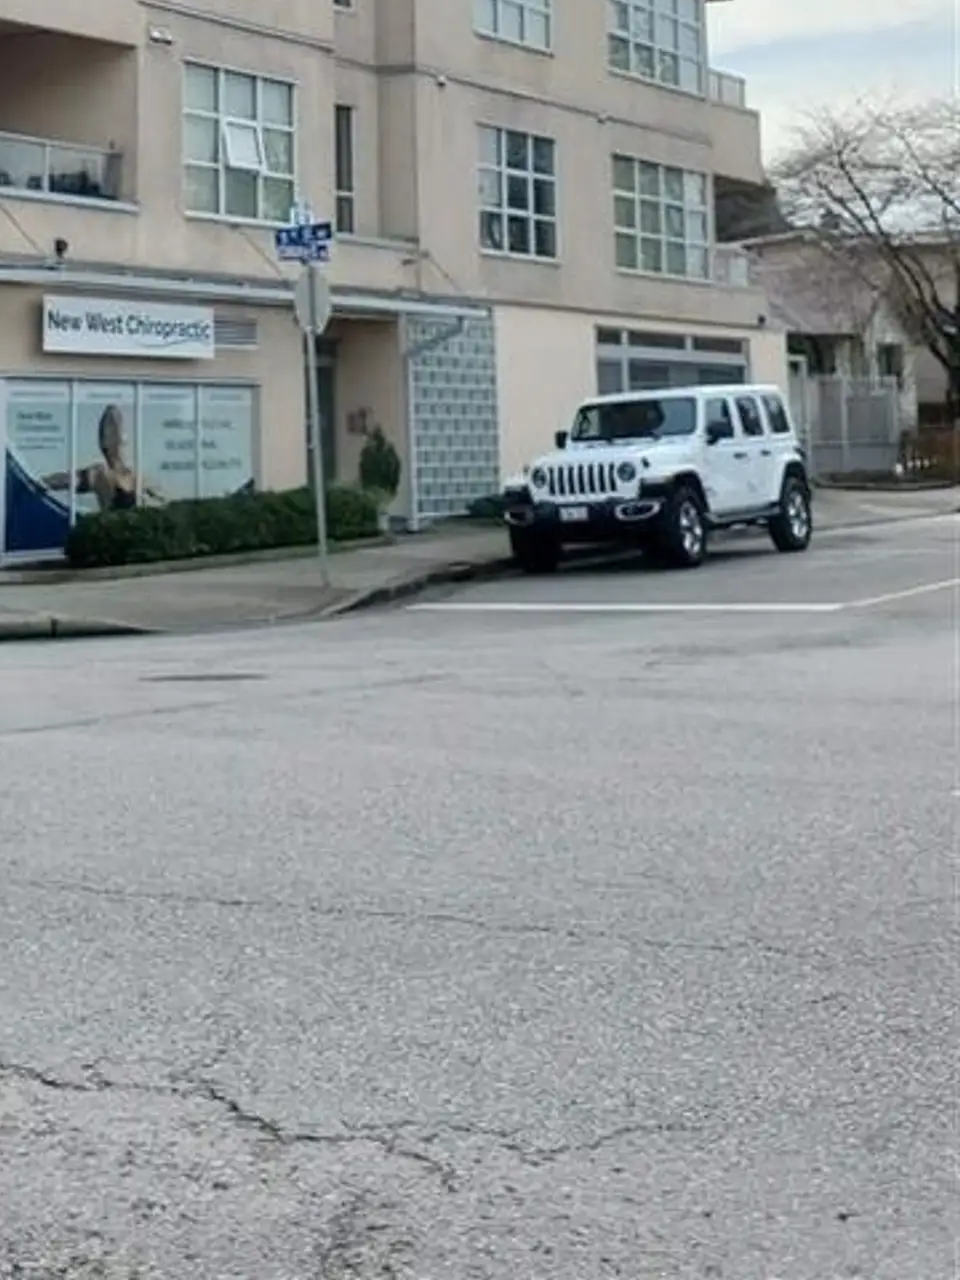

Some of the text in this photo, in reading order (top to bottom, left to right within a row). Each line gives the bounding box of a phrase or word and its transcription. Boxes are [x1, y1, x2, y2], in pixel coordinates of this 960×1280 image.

[48, 310, 211, 340] New West Chiropractic
